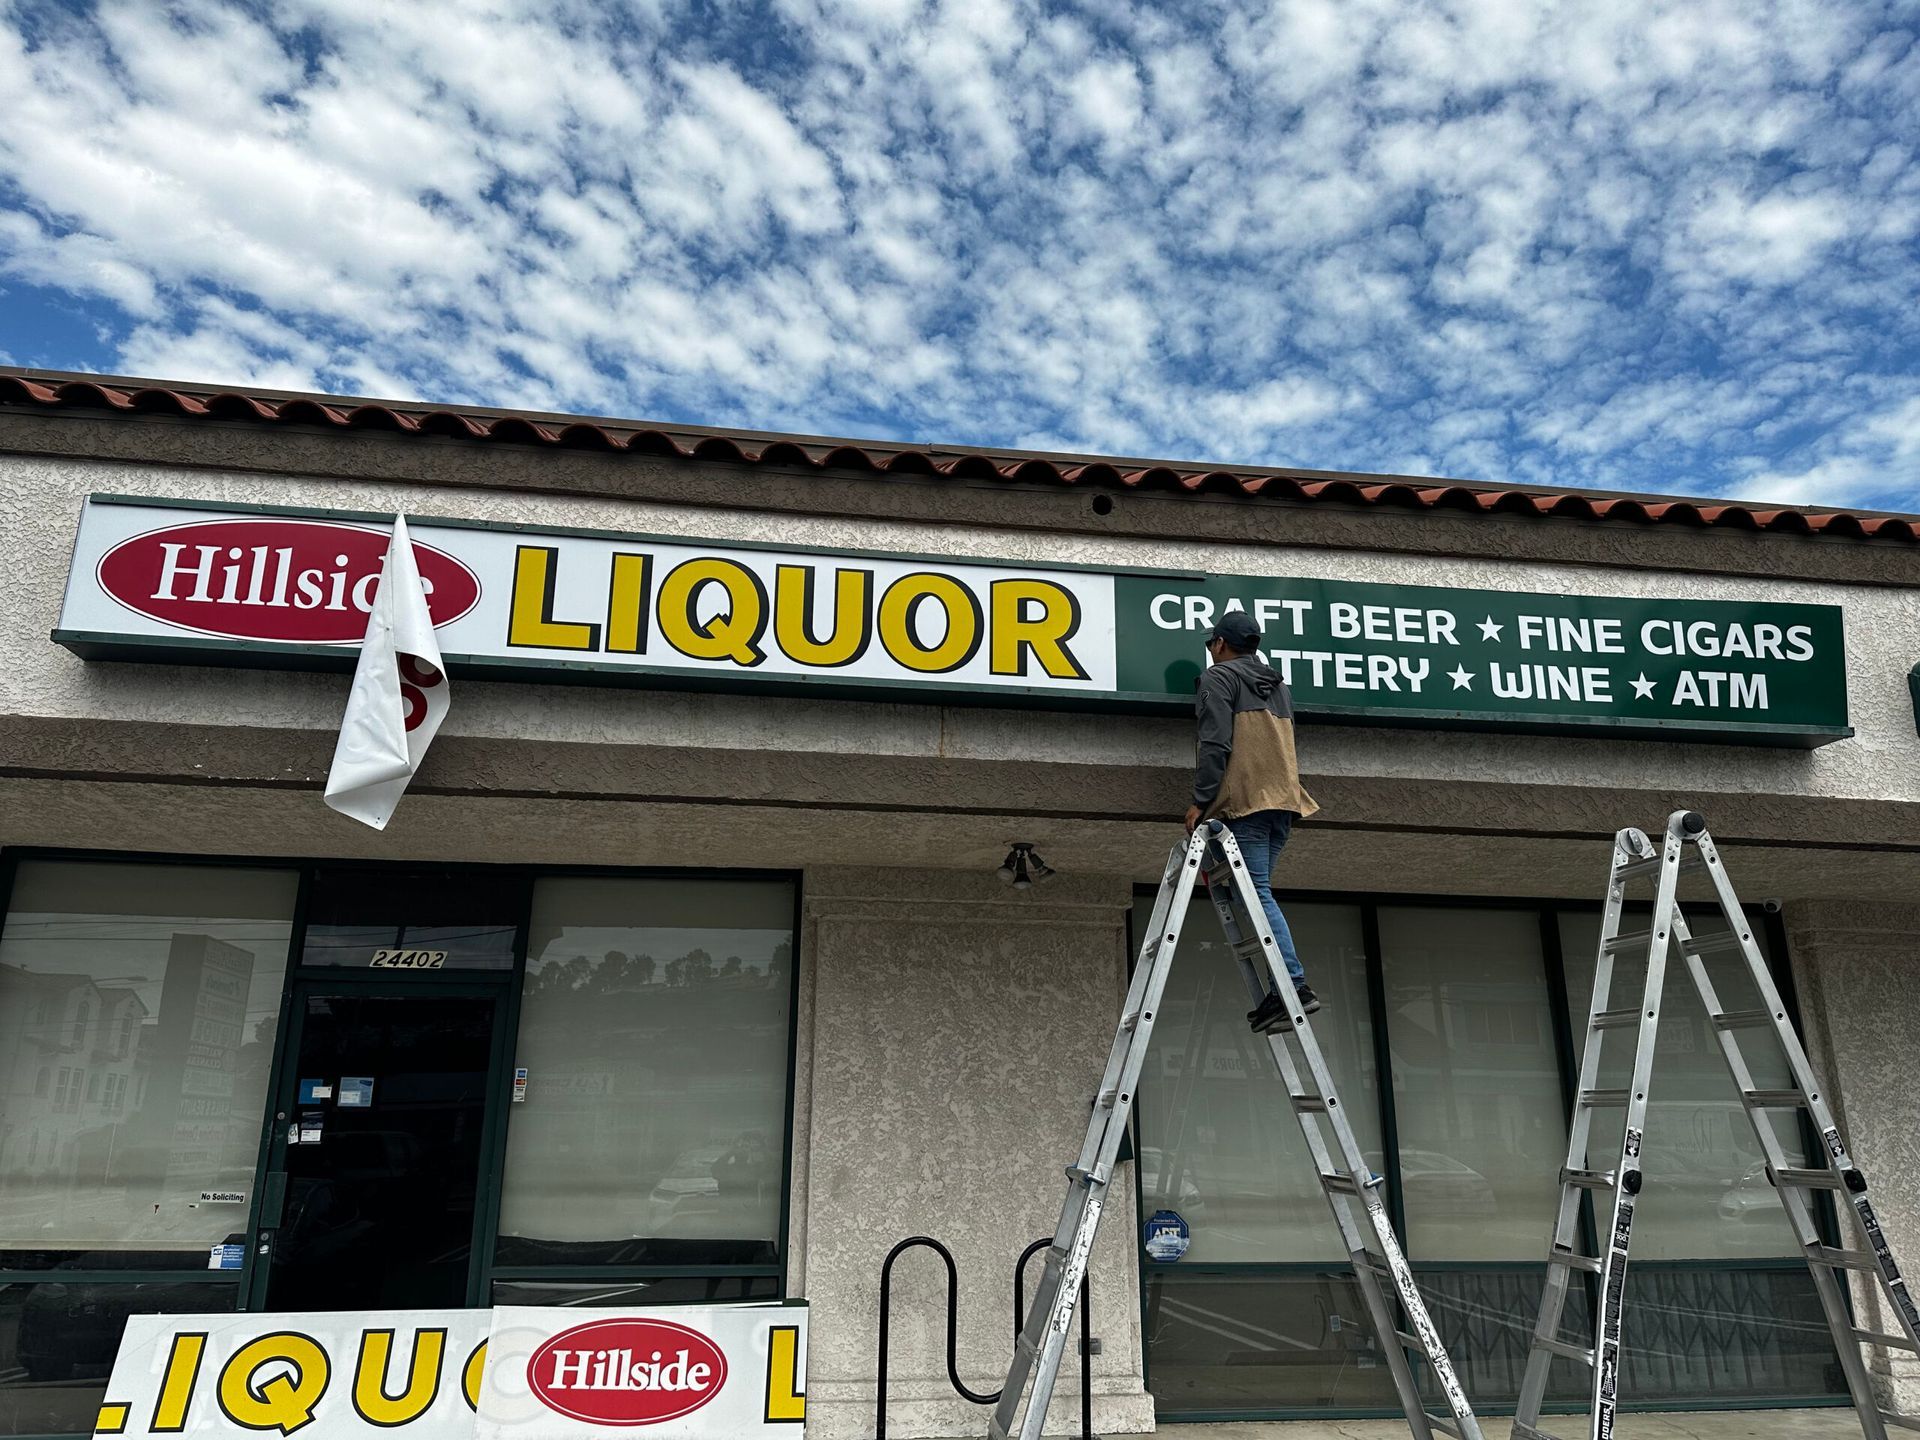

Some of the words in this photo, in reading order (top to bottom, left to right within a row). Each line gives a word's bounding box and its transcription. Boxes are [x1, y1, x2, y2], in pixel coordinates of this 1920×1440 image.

[507, 544, 1091, 681] LIQUOR
[1330, 602, 1460, 645] BEER
[1518, 615, 1625, 653] FINE
[1640, 619, 1814, 661] CIGARS
[1206, 646, 1430, 693] TTERY
[1489, 662, 1613, 702] WINE
[1671, 670, 1769, 709] ATM
[372, 950, 445, 968] 24402
[212, 1193, 244, 1203] Soliciting
[95, 1327, 489, 1437] IQU
[548, 1347, 711, 1392] Hillside
